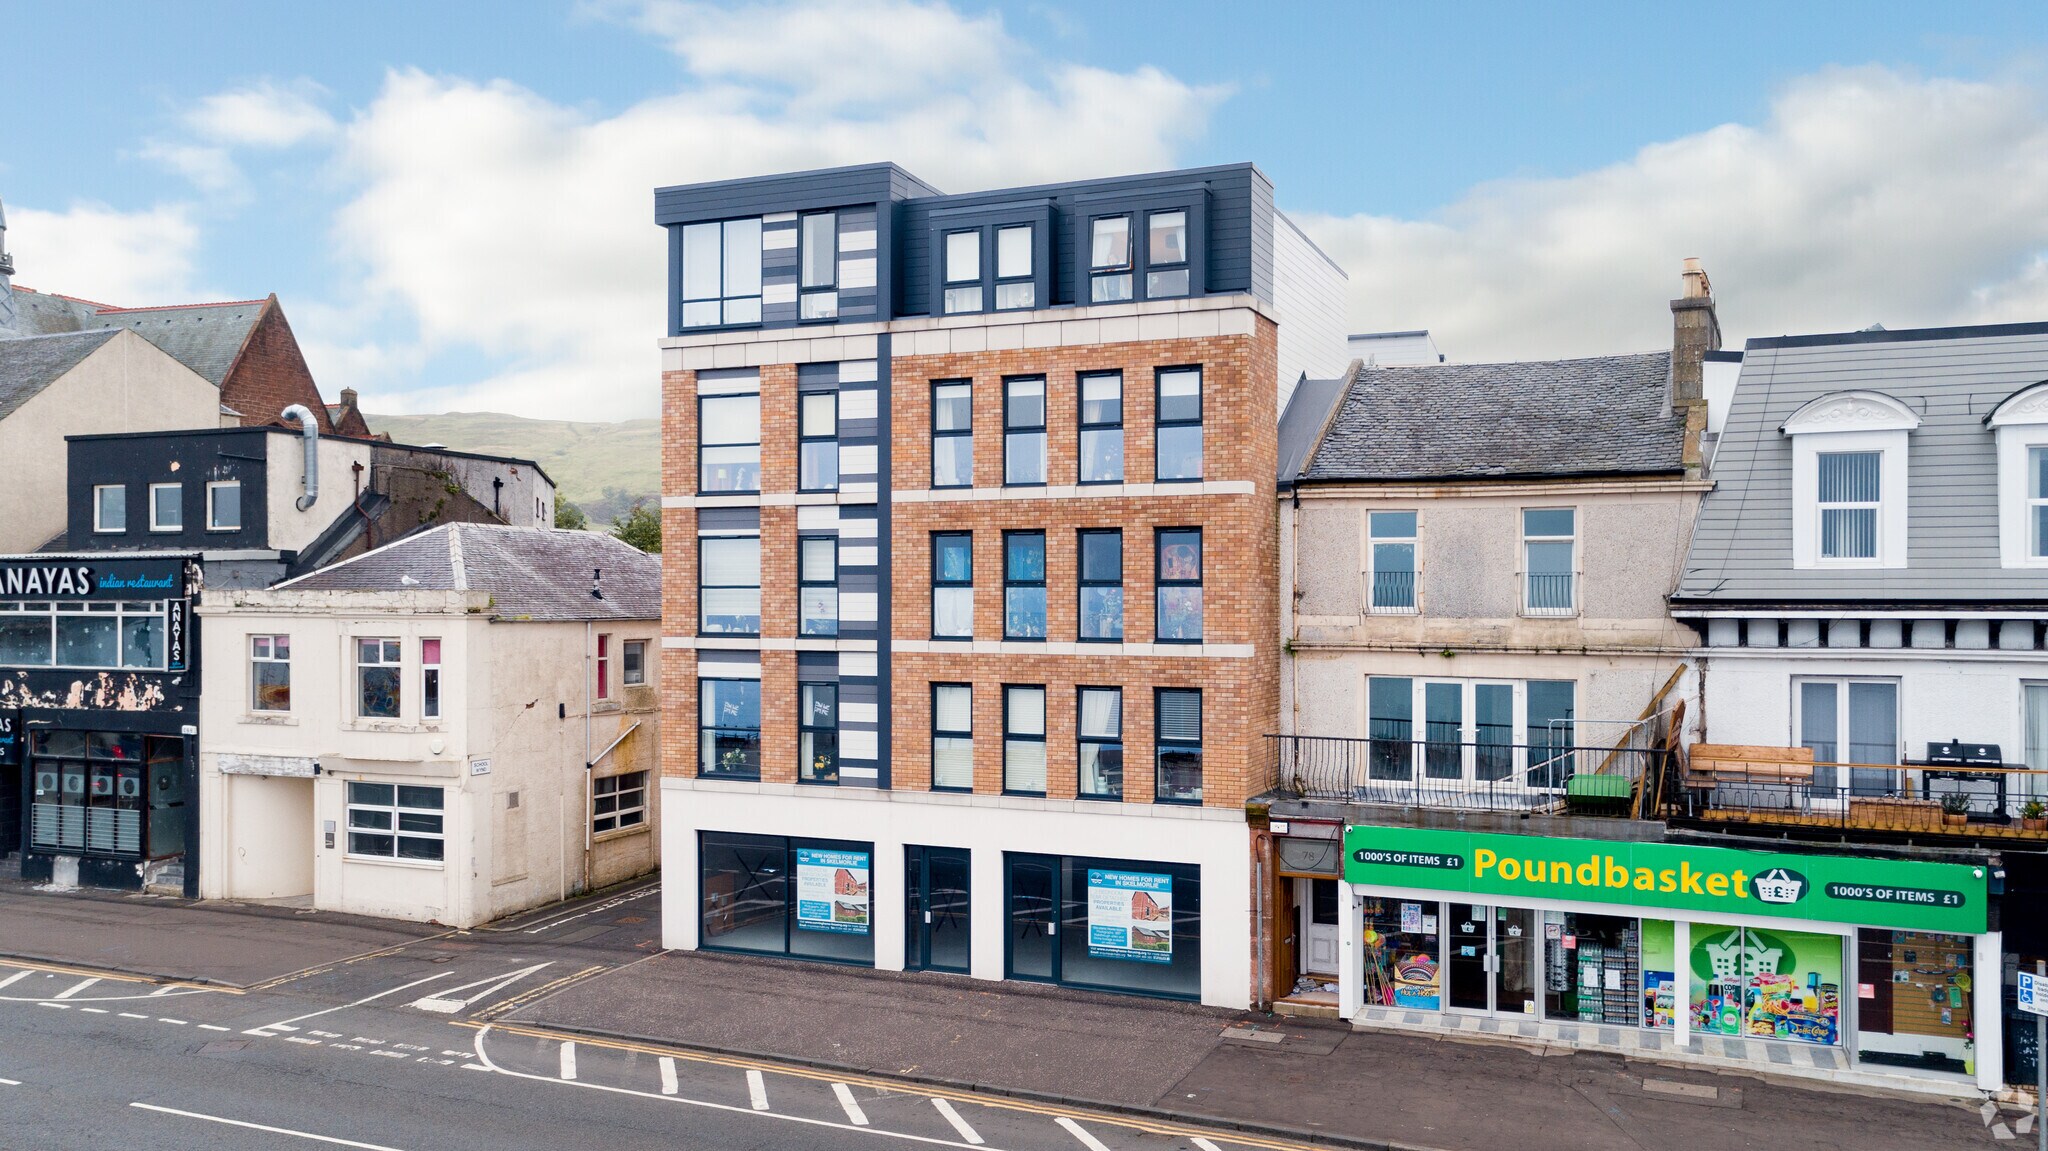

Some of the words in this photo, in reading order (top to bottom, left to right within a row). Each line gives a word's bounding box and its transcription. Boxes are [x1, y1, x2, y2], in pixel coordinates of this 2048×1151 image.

[0, 567, 90, 595] NAYAS
[100, 573, 125, 588] indian
[127, 574, 173, 588] restaurant
[172, 602, 181, 661] ANAYAS
[1302, 851, 1315, 862] 78
[1359, 851, 1392, 862] 1000'S
[1393, 853, 1407, 863] OF
[1409, 855, 1440, 866] ITEMS
[1446, 857, 1459, 867] £1
[1474, 848, 1749, 899] Poundbasket
[1832, 885, 1874, 898] 1000'S
[1875, 888, 1894, 900] OF
[1895, 890, 1935, 903] ITEMS
[1943, 894, 1958, 905] £1
[2023, 976, 2031, 987] P
